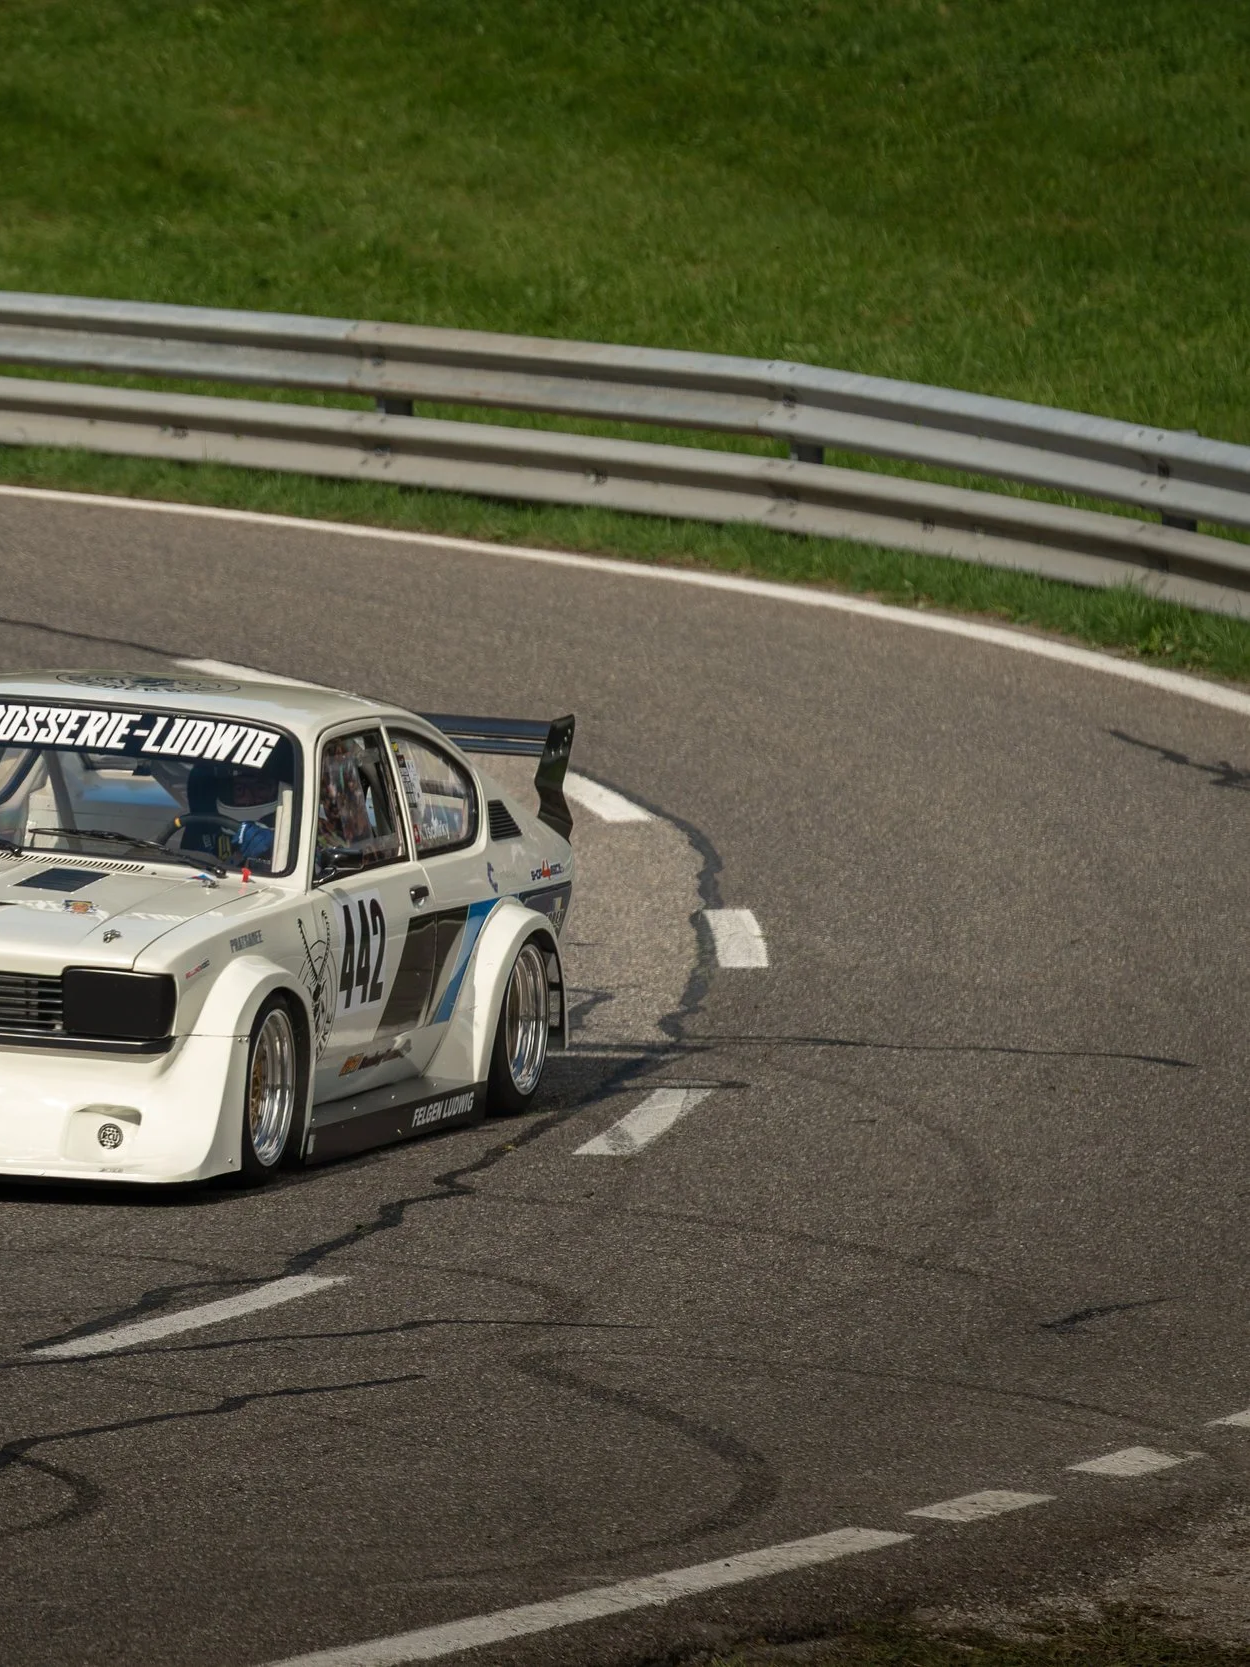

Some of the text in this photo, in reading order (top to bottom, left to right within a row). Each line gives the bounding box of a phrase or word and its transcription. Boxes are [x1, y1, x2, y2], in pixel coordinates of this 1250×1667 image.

[339, 898, 386, 1009] 442
[411, 1091, 475, 1129] FELGEN LUDWIG
